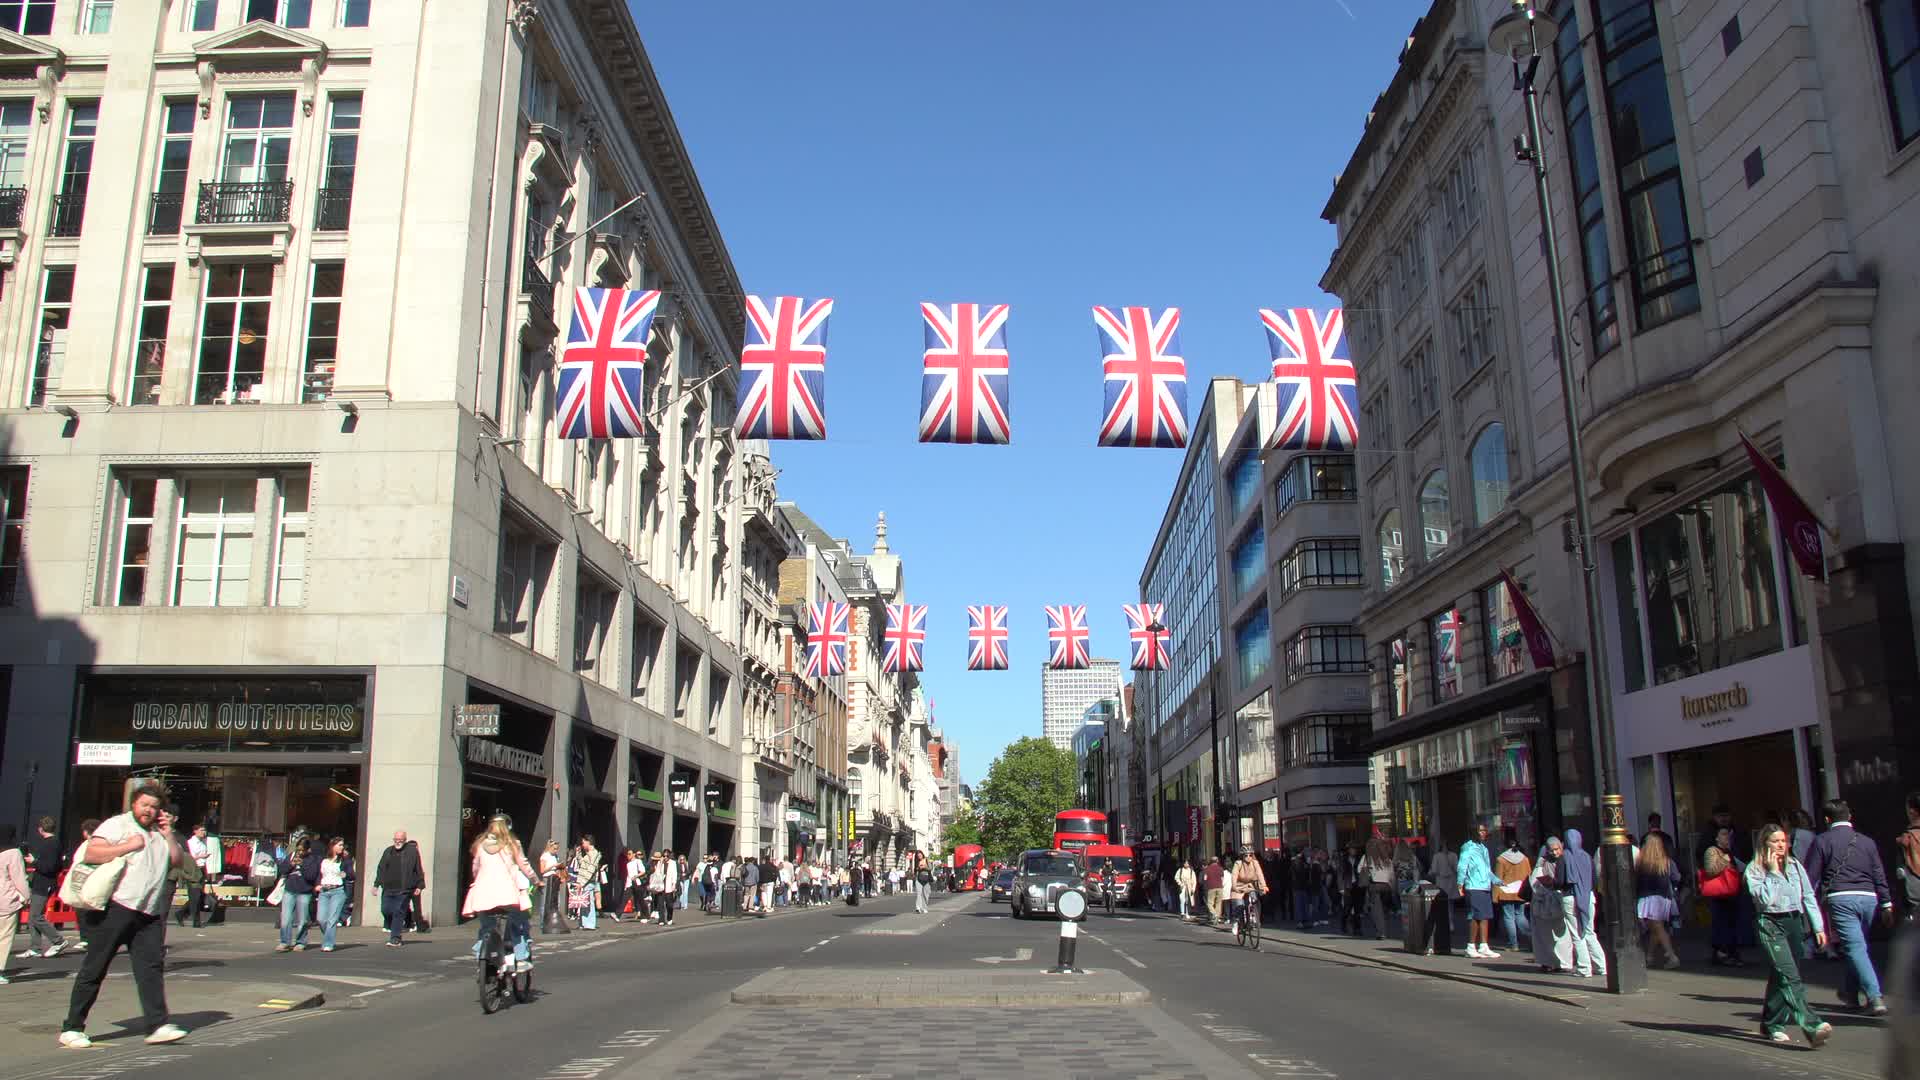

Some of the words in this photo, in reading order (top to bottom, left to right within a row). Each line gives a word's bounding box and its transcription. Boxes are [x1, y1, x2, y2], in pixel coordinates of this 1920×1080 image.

[132, 703, 208, 730] URBAN
[216, 703, 354, 731] OUTFITTERS
[600, 1028, 672, 1048] LEFT
